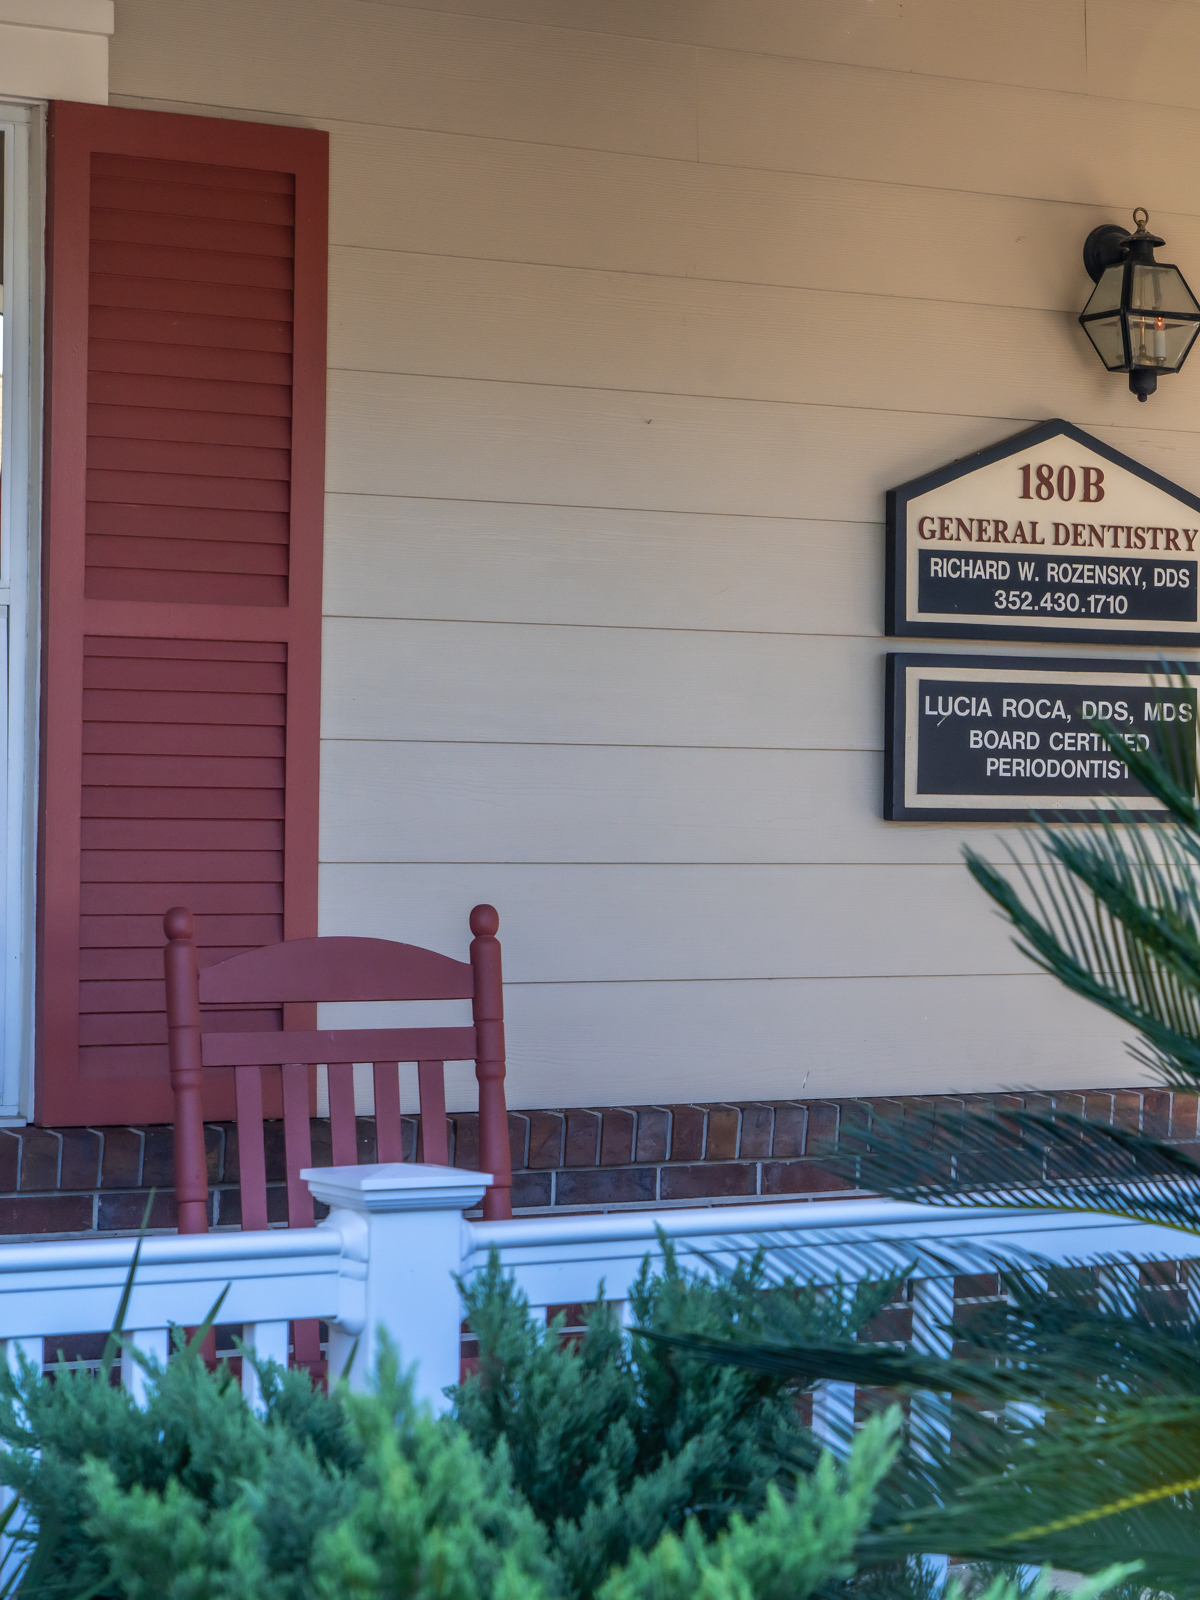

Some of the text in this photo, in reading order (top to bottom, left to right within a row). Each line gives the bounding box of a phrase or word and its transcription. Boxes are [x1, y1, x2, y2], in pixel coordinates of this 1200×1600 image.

[1018, 463, 1106, 503] 180B
[918, 516, 1199, 552] GENERAL DENTISTRY
[930, 557, 1190, 590] RICHARD W. ROZENSKY, DDS
[994, 590, 1129, 615] 352.430.1710
[924, 695, 1193, 725] LUCIA ROCA, DDS, MDS
[969, 730, 1040, 750] BOARD
[986, 757, 1130, 779] PERIODONTIST
